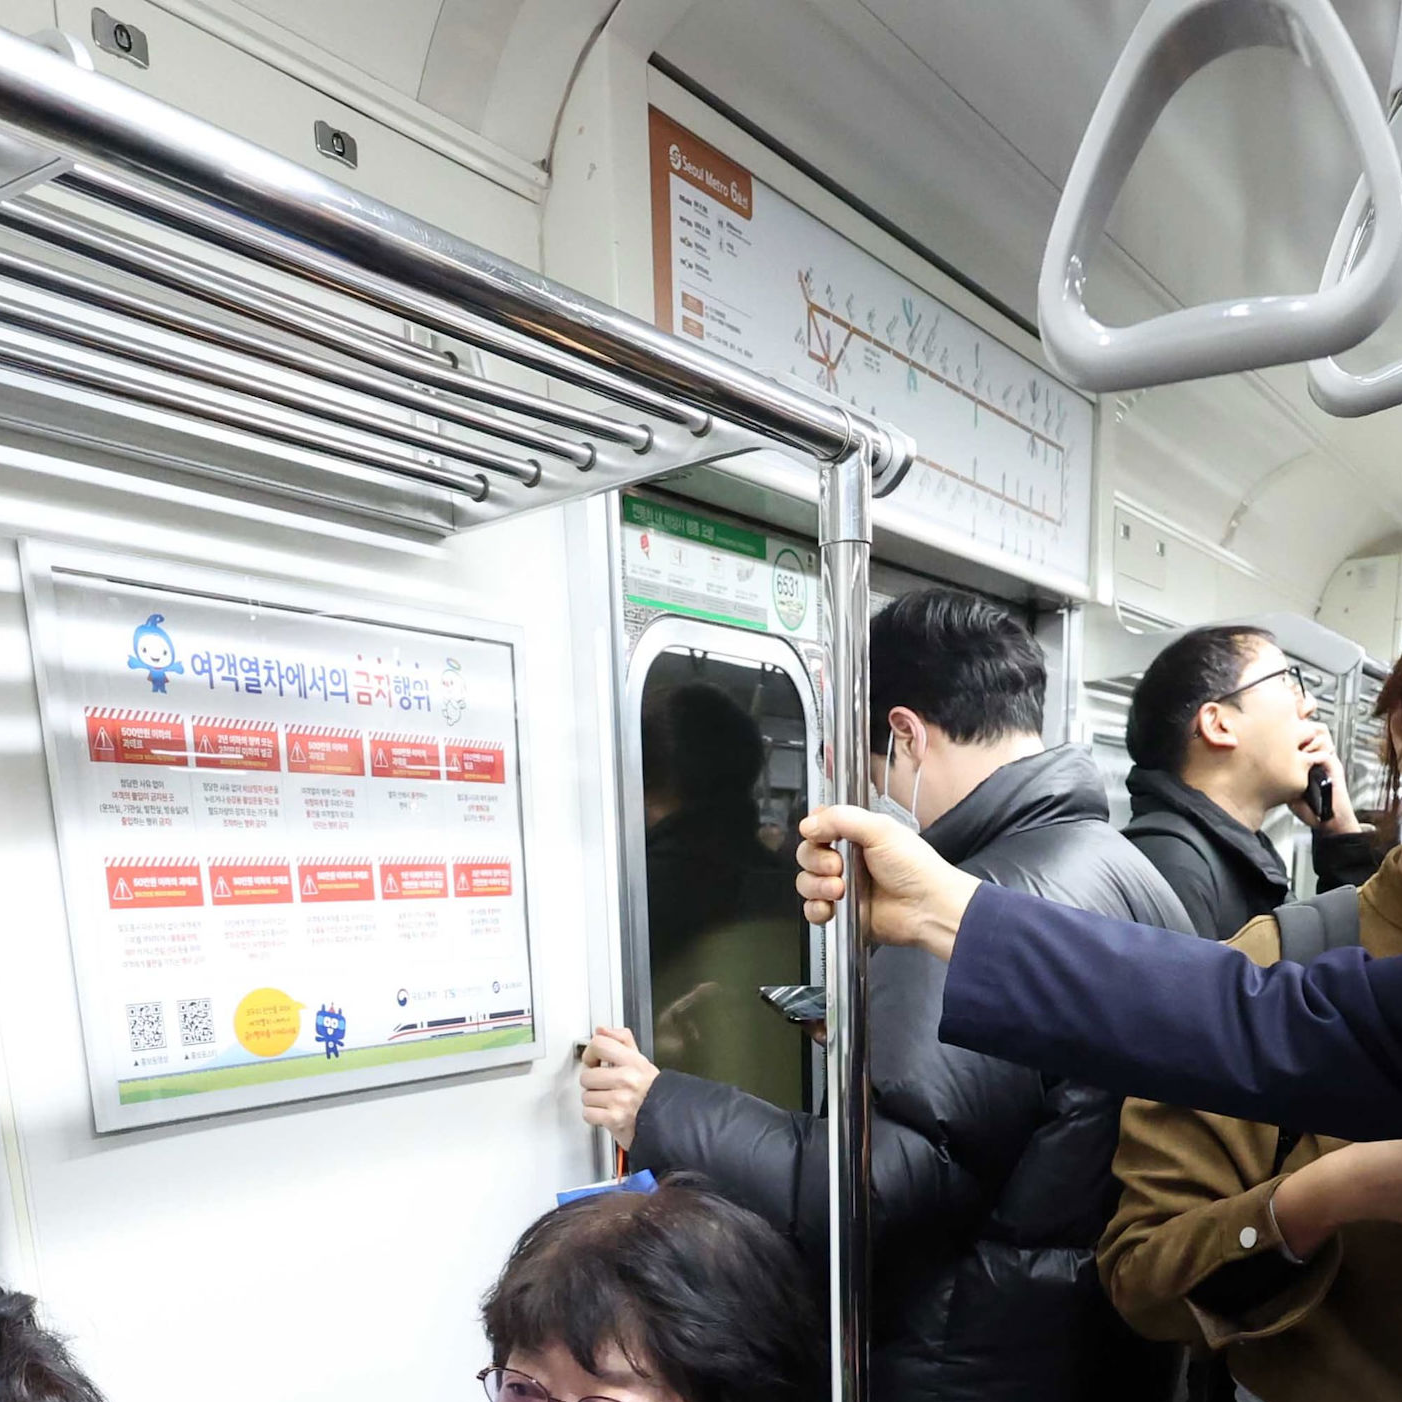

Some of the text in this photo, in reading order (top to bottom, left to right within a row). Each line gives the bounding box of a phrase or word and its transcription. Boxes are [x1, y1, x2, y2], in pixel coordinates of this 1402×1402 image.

[682, 155, 704, 181] Seoul
[705, 170, 729, 197] Metro
[776, 573, 799, 597] 6531
[191, 651, 431, 712] 여객열차에서의 금지행위
[121, 727, 150, 739] 500만원
[122, 739, 144, 750] 과태료
